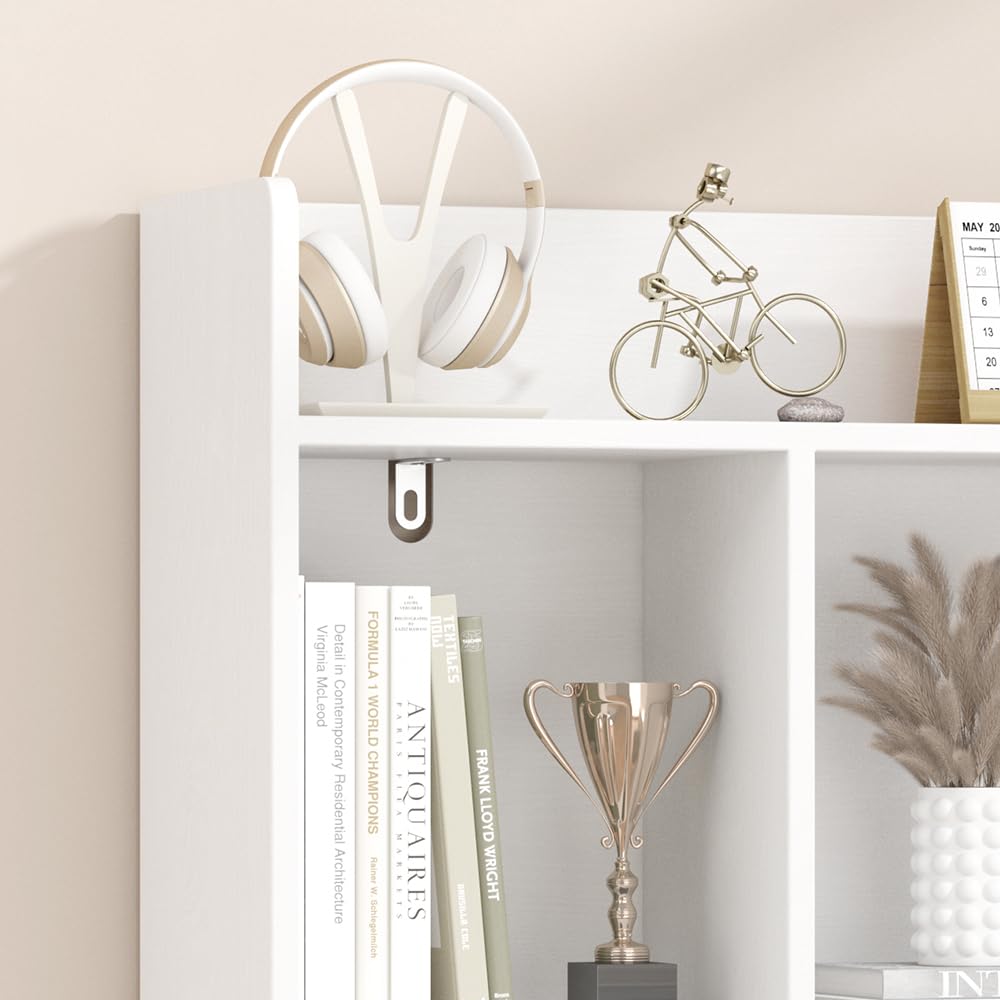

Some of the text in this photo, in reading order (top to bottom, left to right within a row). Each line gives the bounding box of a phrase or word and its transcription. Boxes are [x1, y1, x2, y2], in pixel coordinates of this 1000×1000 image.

[962, 222, 983, 231] MAY
[982, 297, 987, 306] 6
[984, 327, 993, 337] 13
[986, 357, 997, 367] 20
[314, 625, 328, 727] Virginia McLeod
[367, 611, 379, 680] FORMULA
[367, 694, 379, 747] WORLD
[331, 624, 347, 924] Detail in Contemporary Residential Architecture
[367, 750, 379, 834] CHAMPIONS
[403, 700, 426, 921] ANTIQUAIRES
[475, 748, 500, 901] FRANK LLOYD WRIGHT
[370, 886, 377, 897] W.
